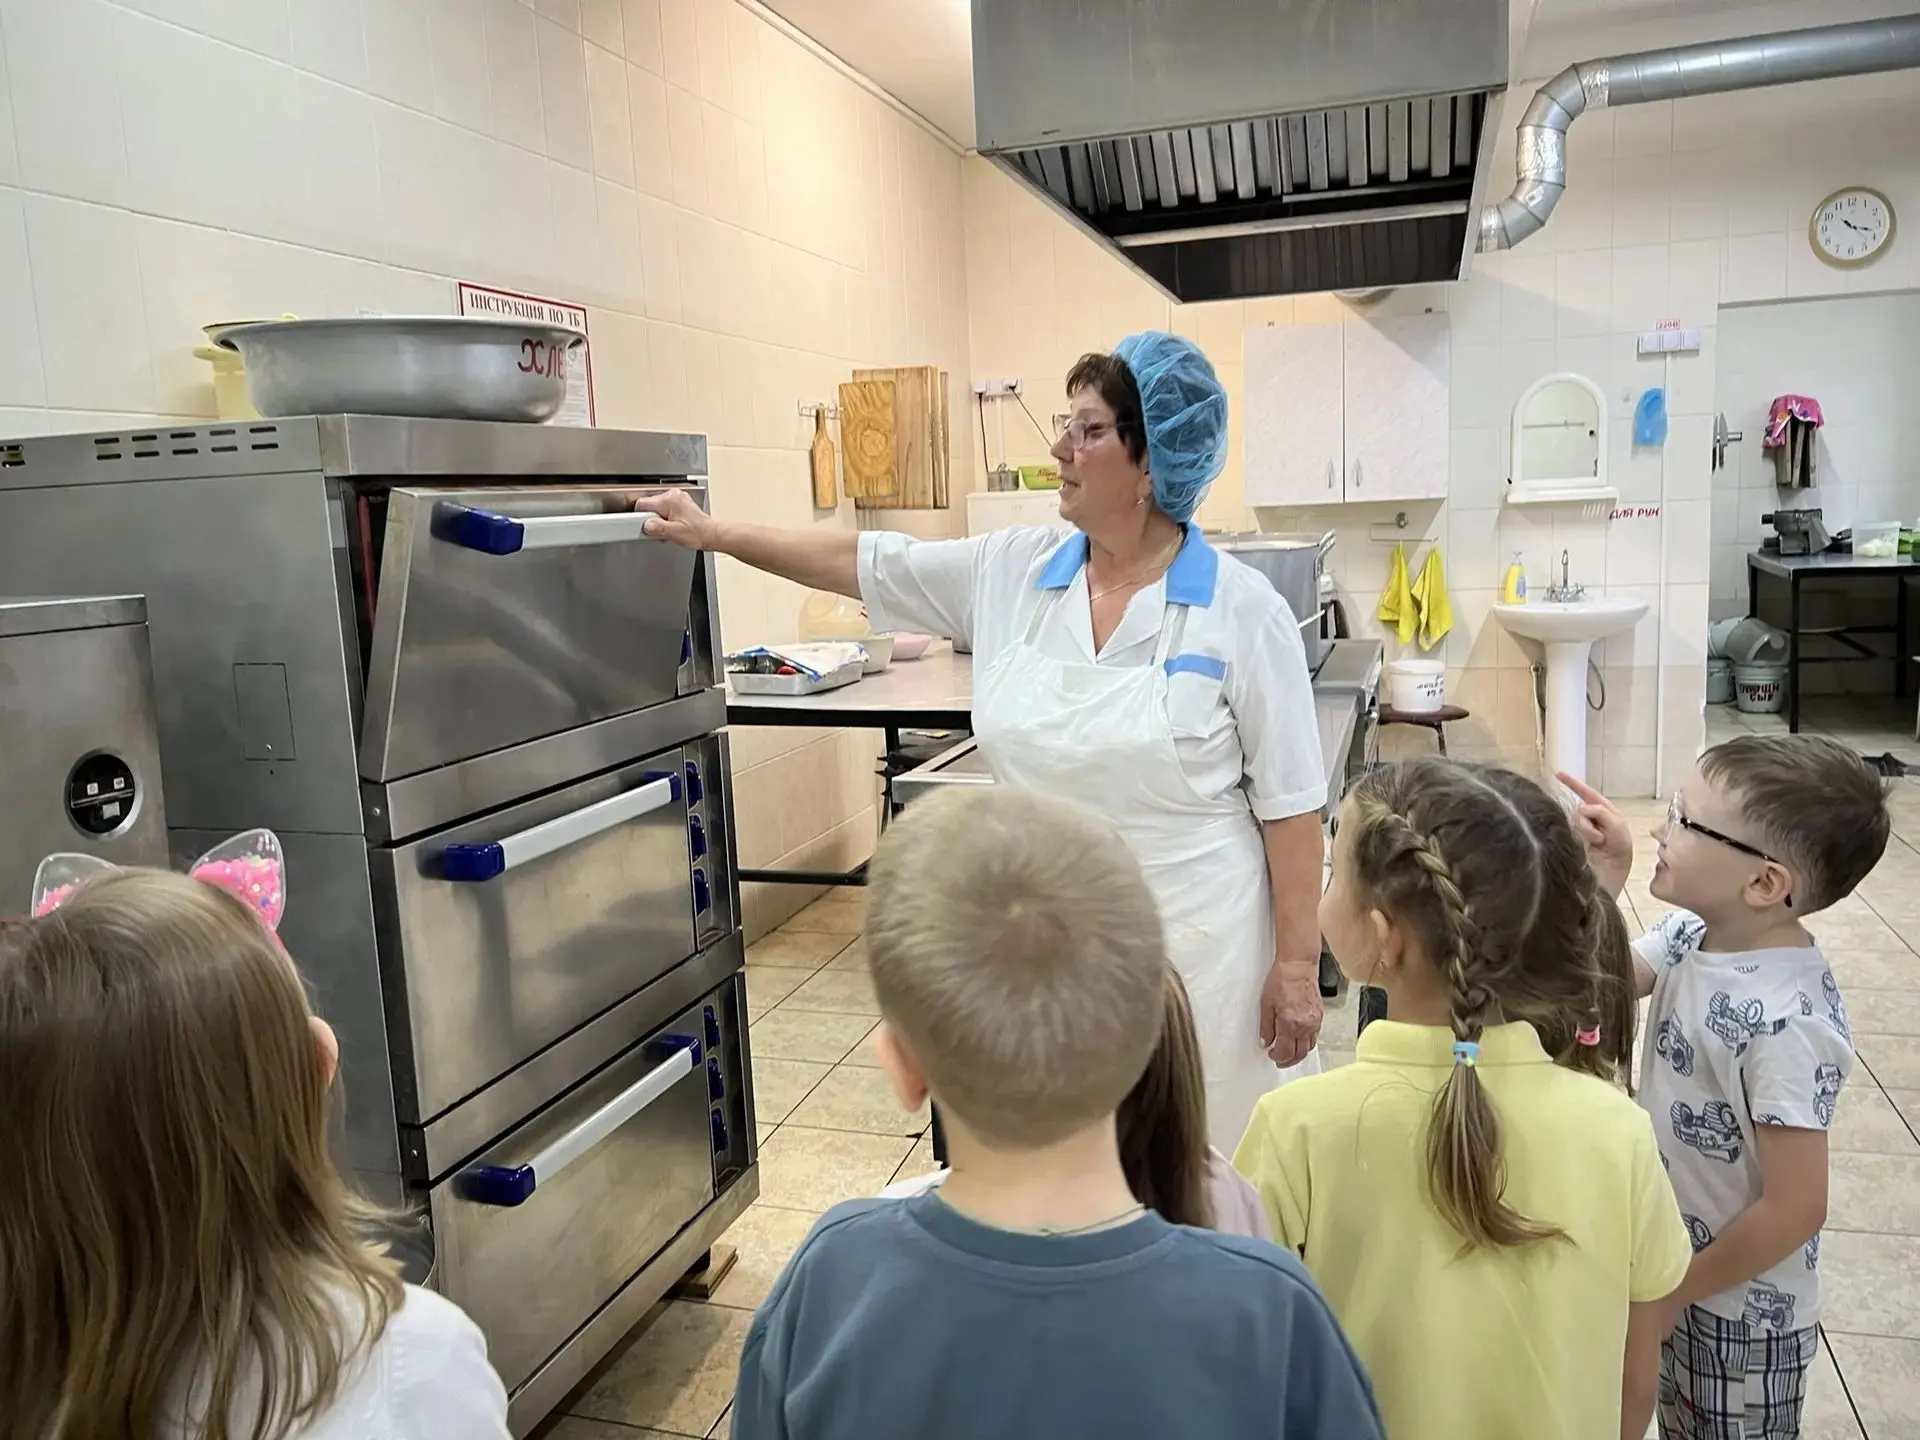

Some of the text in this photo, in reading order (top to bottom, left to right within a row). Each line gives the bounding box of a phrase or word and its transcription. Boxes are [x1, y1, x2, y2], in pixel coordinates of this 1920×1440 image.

[470, 293, 580, 327] ИНСТРУКЦИЯ ПО ТБ
